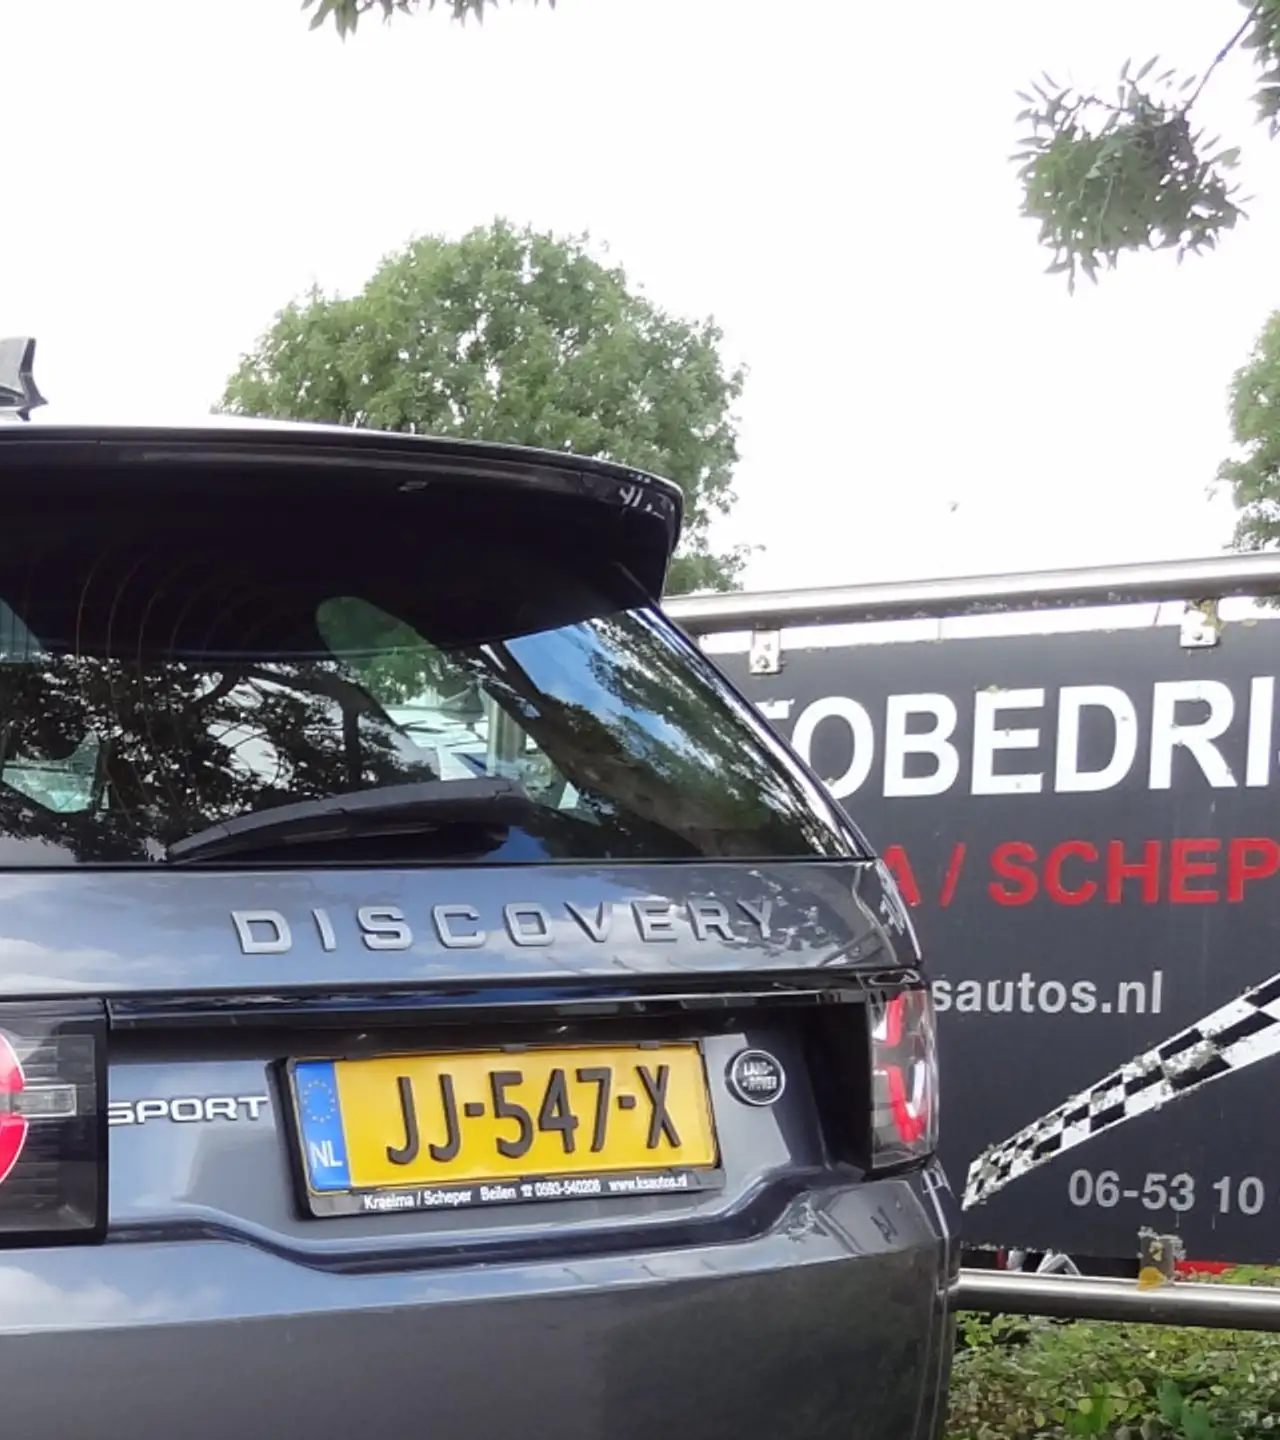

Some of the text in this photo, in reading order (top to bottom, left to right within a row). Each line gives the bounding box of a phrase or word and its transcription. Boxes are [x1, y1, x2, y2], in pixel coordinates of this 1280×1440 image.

[754, 675, 1280, 801] OBEDRI
[988, 837, 1280, 906] SCHEP
[230, 900, 774, 954] DISCOVERY
[931, 970, 1163, 1015] sautos.nl
[107, 1095, 270, 1126] SPORT
[385, 1063, 682, 1166] JJ-547-X
[309, 1140, 343, 1169] NL
[424, 1189, 473, 1207] Scheper
[1067, 1168, 1266, 1216] 06-53 10
